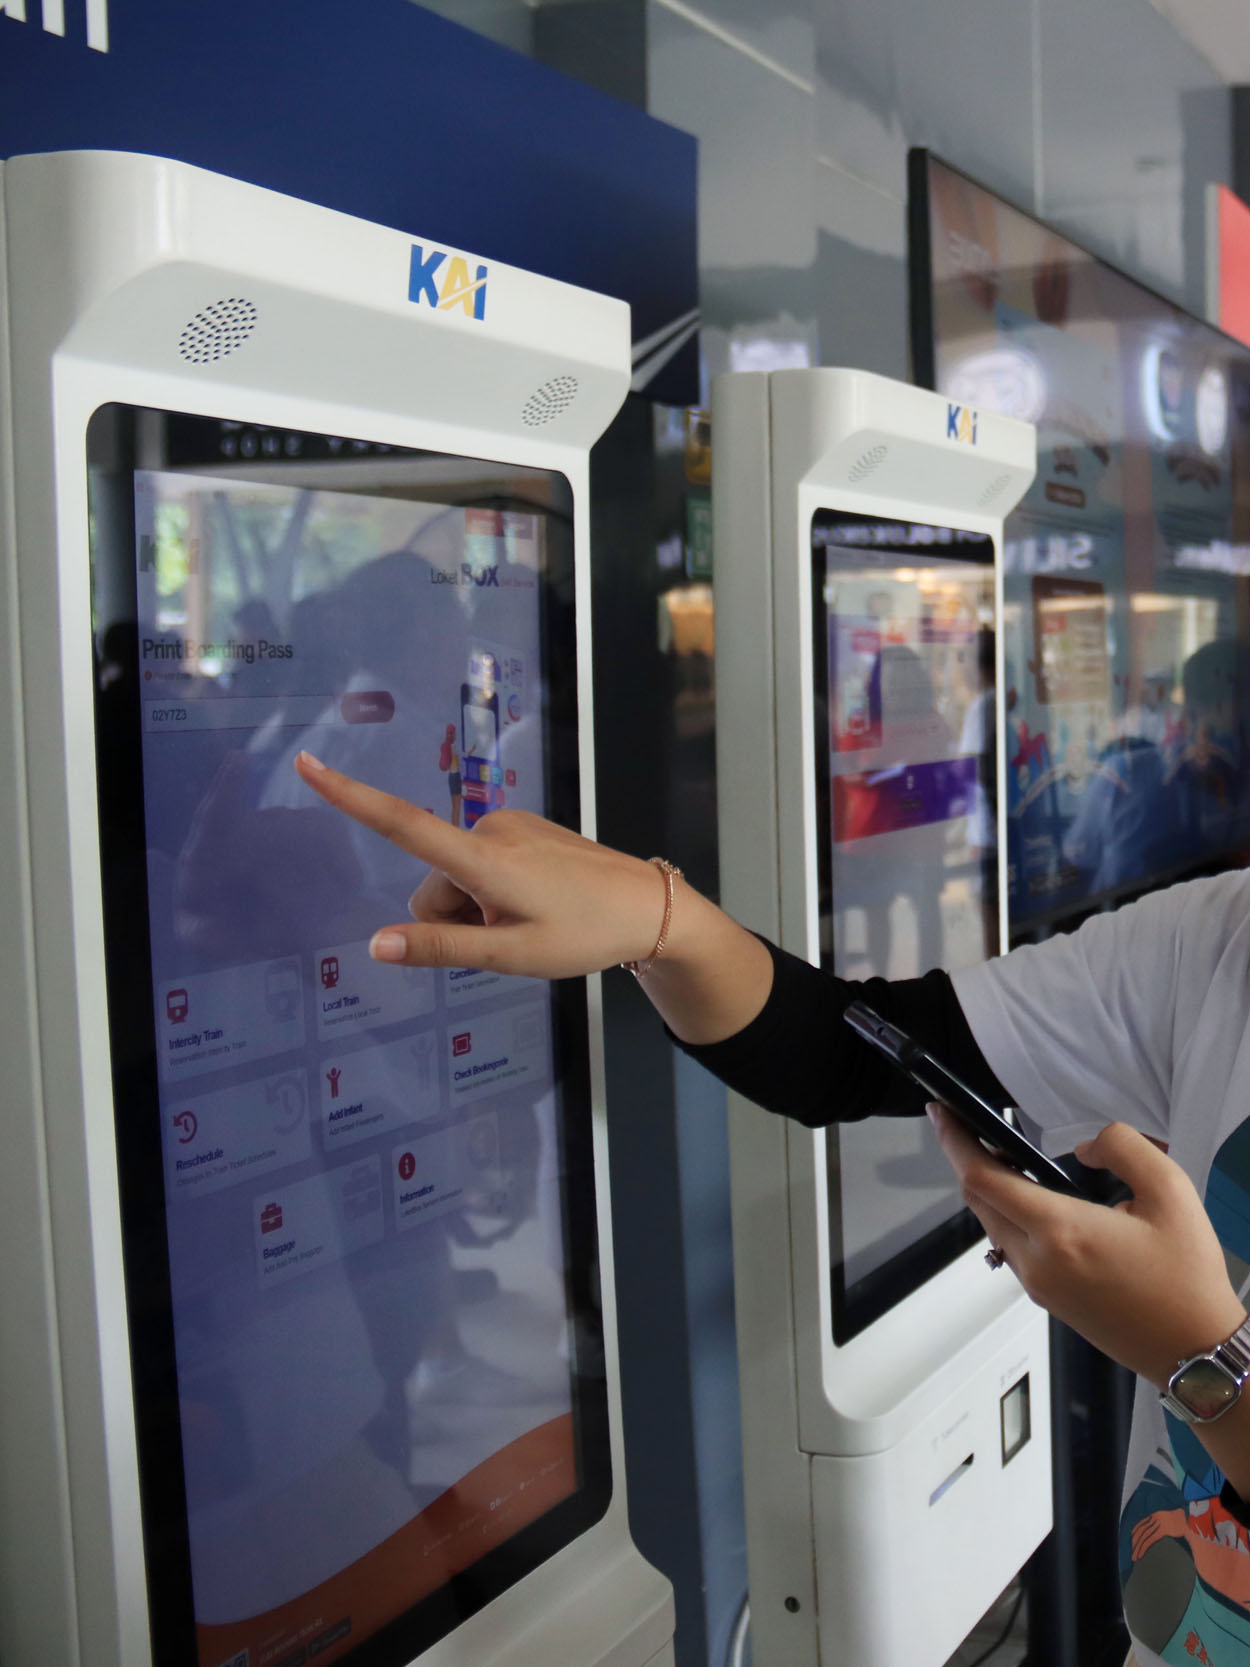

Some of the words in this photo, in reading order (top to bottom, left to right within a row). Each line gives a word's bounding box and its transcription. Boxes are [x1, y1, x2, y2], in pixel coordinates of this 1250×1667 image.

[408, 244, 487, 321] KAI
[947, 403, 977, 446] KAI
[431, 567, 458, 586] Loket
[142, 639, 182, 661] Print
[185, 640, 255, 664] Boarding
[258, 640, 293, 660] Pass
[323, 998, 342, 1012] Local
[342, 994, 360, 1008] Train
[168, 1032, 202, 1050] Intercity
[203, 1028, 224, 1042] Train
[454, 1067, 472, 1081] Check
[328, 1109, 344, 1123] Add
[176, 1147, 224, 1172] Reschedule
[400, 1184, 435, 1204] Information
[263, 1240, 296, 1260] Baggage
